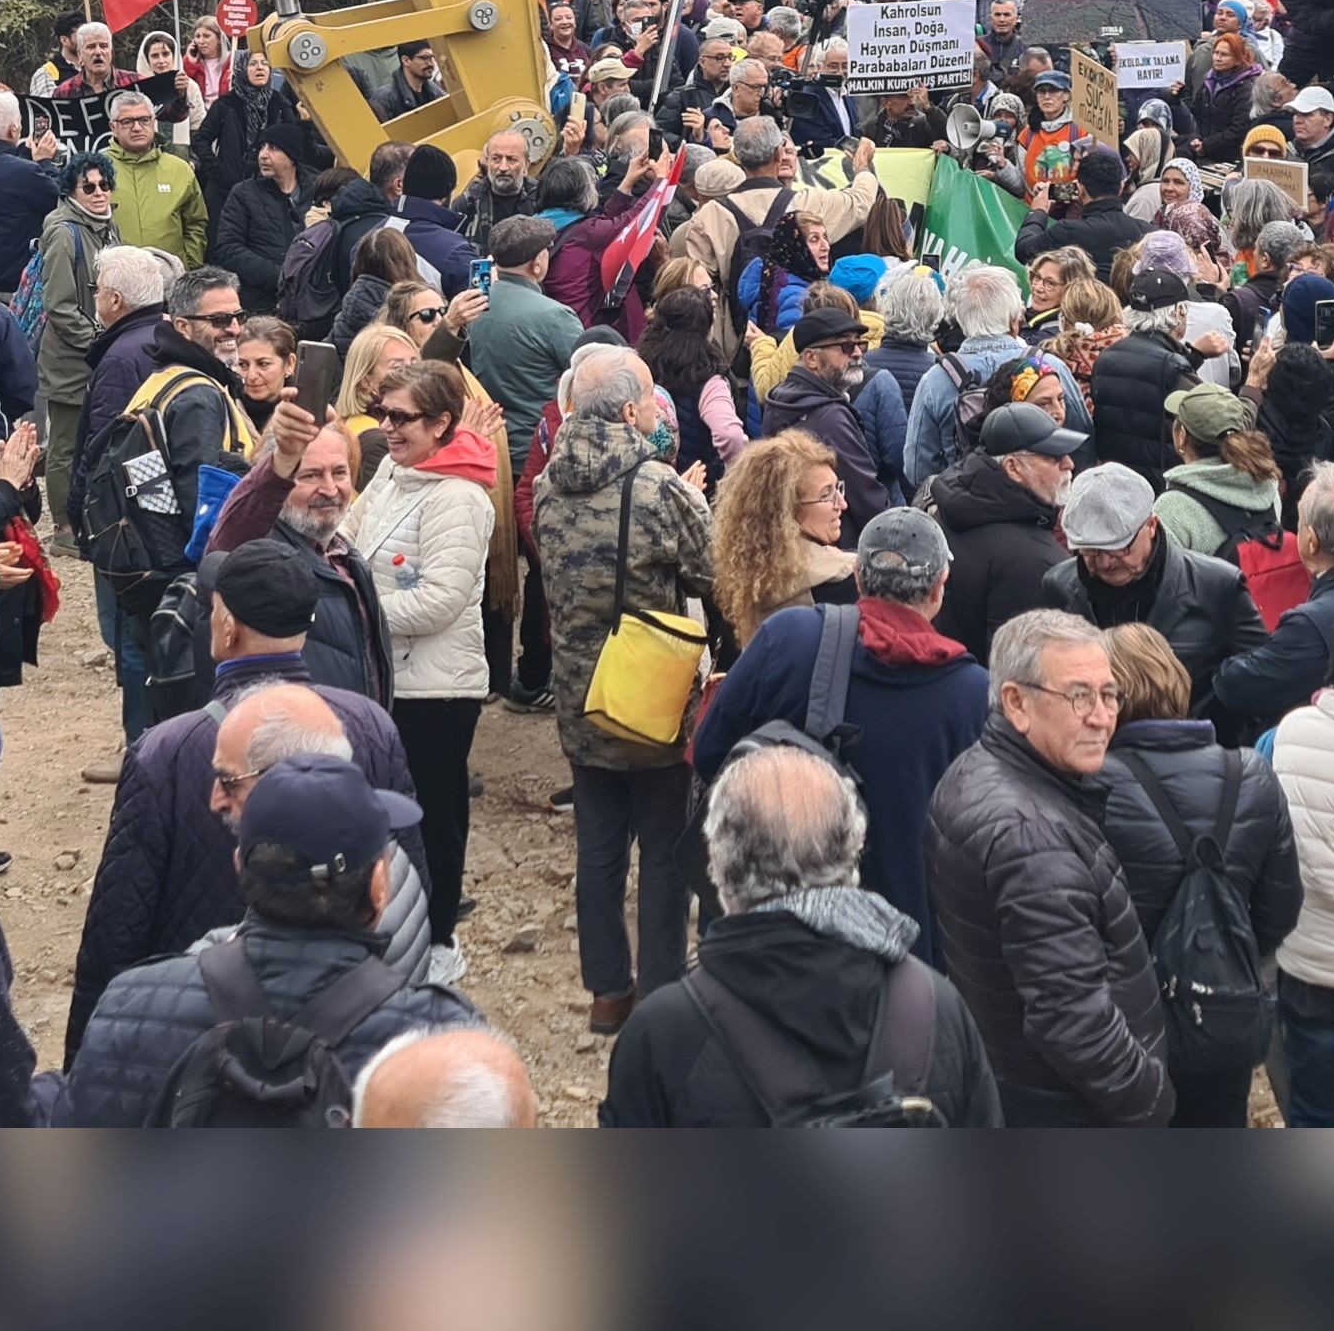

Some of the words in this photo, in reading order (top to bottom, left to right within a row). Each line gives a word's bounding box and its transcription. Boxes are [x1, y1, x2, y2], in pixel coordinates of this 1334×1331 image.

[880, 4, 942, 19] Kahrolsun
[874, 21, 910, 38] İnsan,
[914, 20, 947, 37] Doğa,
[860, 42, 906, 58] Hayvan
[910, 39, 959, 55] Düşmanı
[850, 58, 927, 74] Parababaları
[930, 52, 971, 69] Düzeni!
[1153, 55, 1181, 66] TALANA
[849, 78, 885, 91] HALKIN
[937, 70, 971, 85] PARTİSİ
[1137, 69, 1163, 81] HAYIR!
